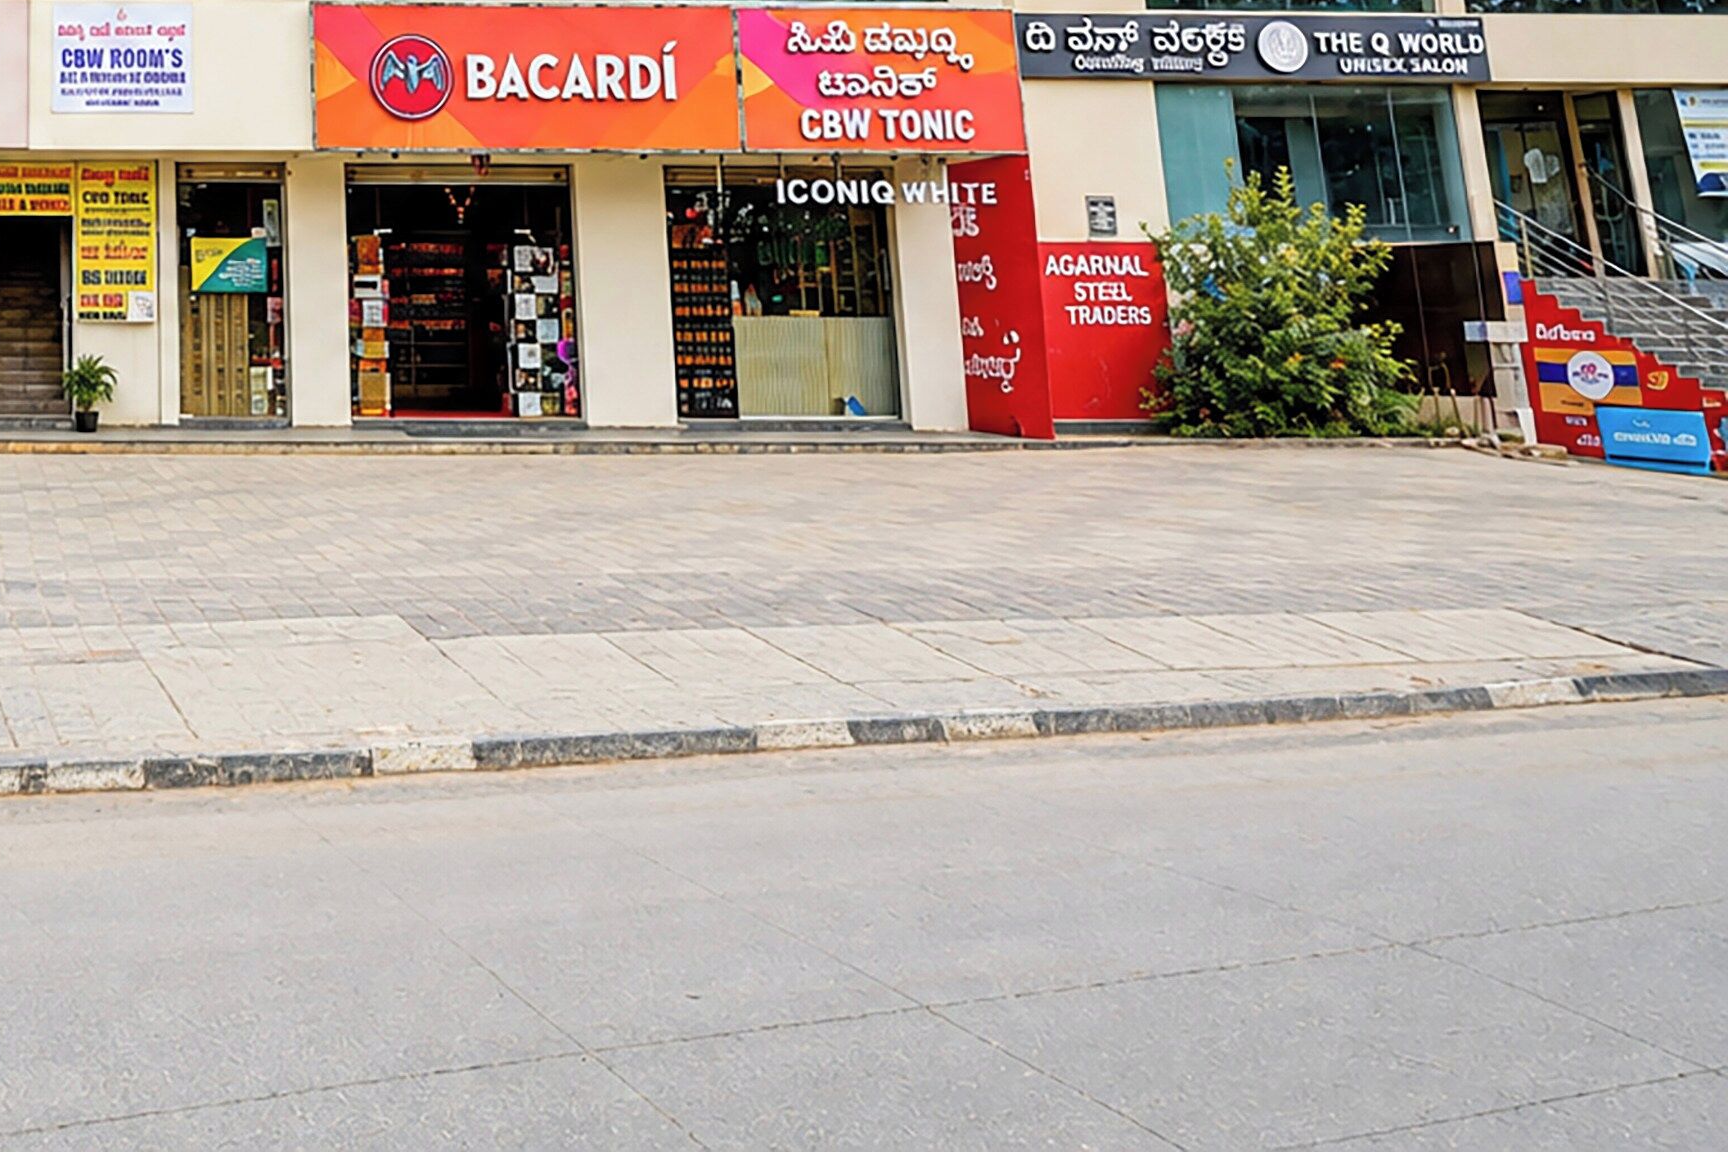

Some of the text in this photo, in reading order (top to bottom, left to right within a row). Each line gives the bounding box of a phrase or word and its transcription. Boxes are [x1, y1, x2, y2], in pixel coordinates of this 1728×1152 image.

[1314, 32, 1484, 56] THE Q WORLD
[62, 48, 104, 69] CBW
[801, 108, 975, 140] CBW TONIC
[776, 179, 998, 205] ICONIQ WHITE
[1064, 306, 1152, 325] TRADERS
